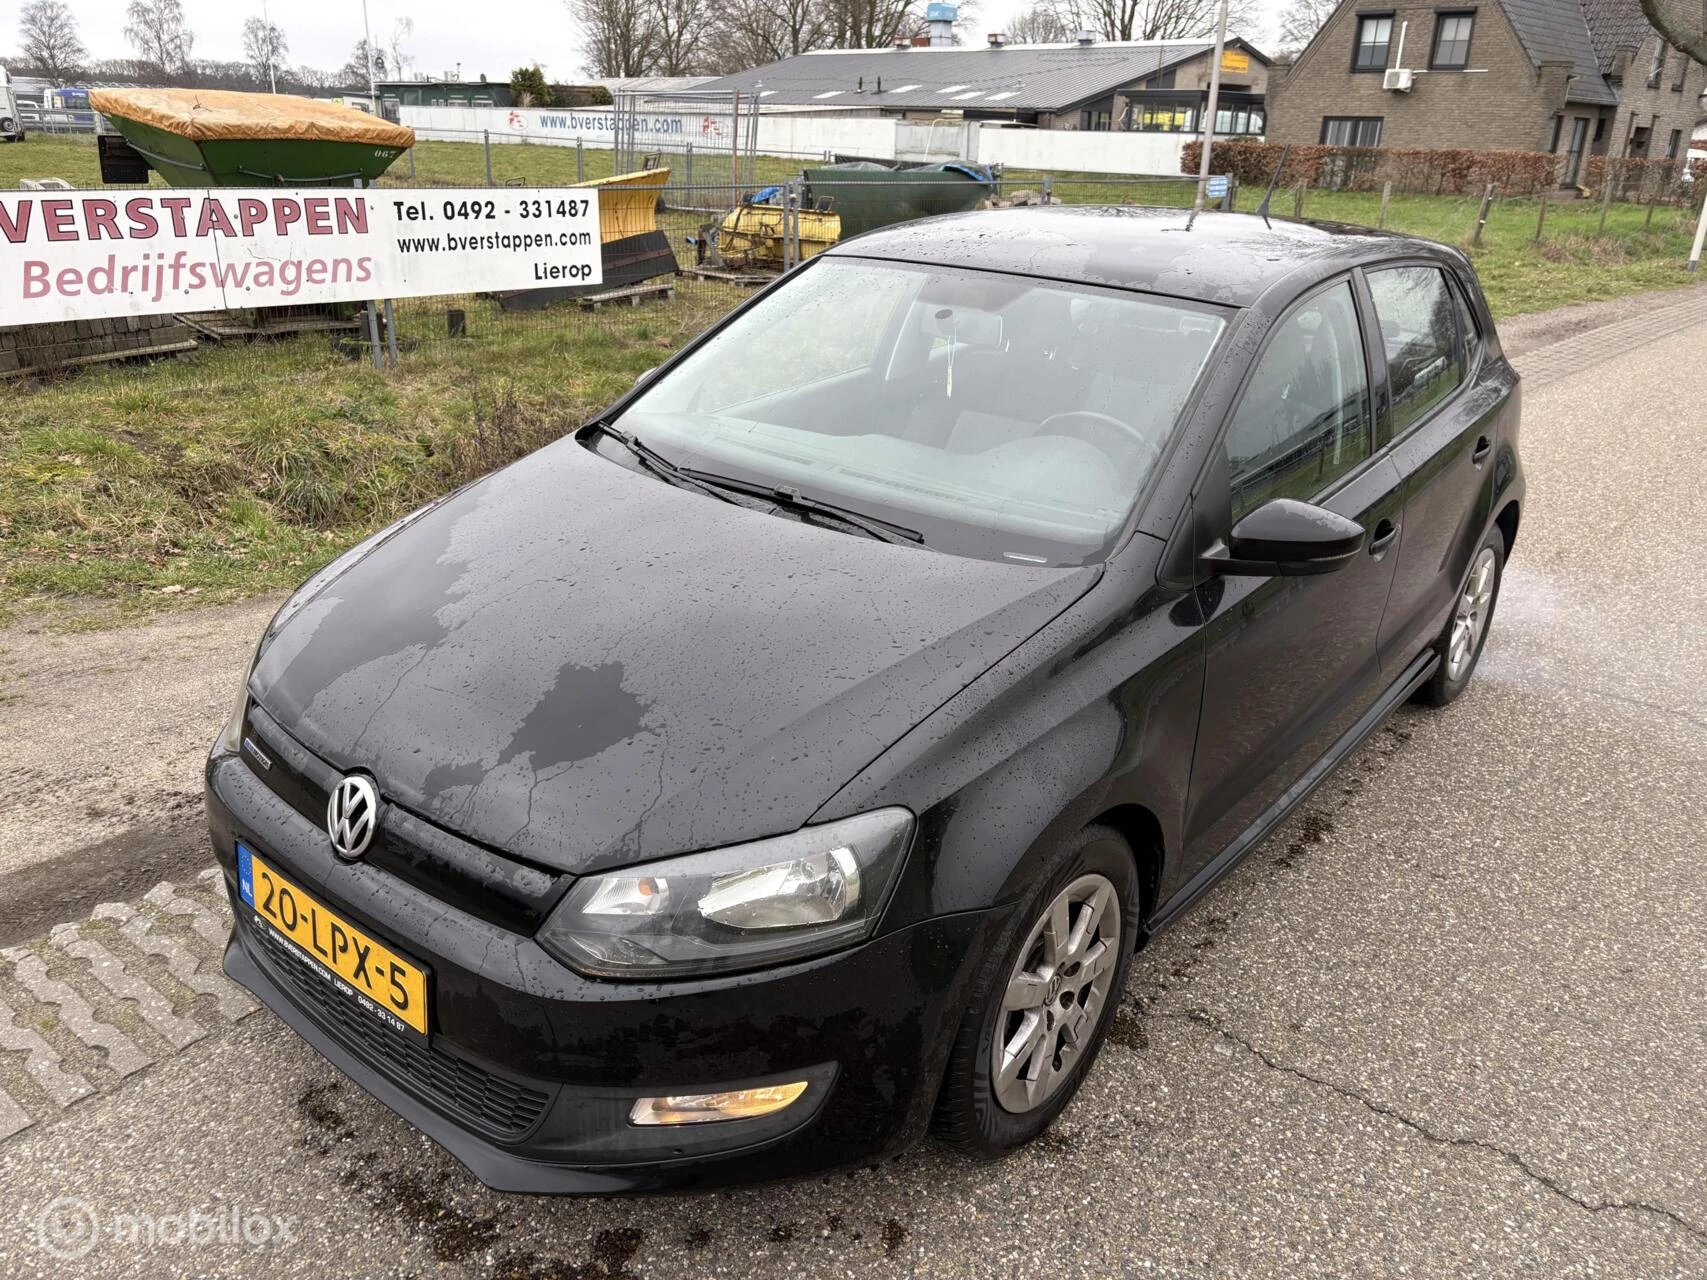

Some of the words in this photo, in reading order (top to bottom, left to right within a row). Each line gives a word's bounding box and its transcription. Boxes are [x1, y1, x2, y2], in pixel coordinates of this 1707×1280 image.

[393, 201, 434, 221] Tel.
[443, 201, 496, 220] 0492
[519, 200, 589, 219] 331487
[397, 231, 591, 252] www.bverstappen.com
[23, 251, 372, 302] Bedrijfswagens
[534, 262, 592, 281] Lierop
[242, 879, 253, 897] NL
[261, 872, 408, 1010] 20-LPX-5
